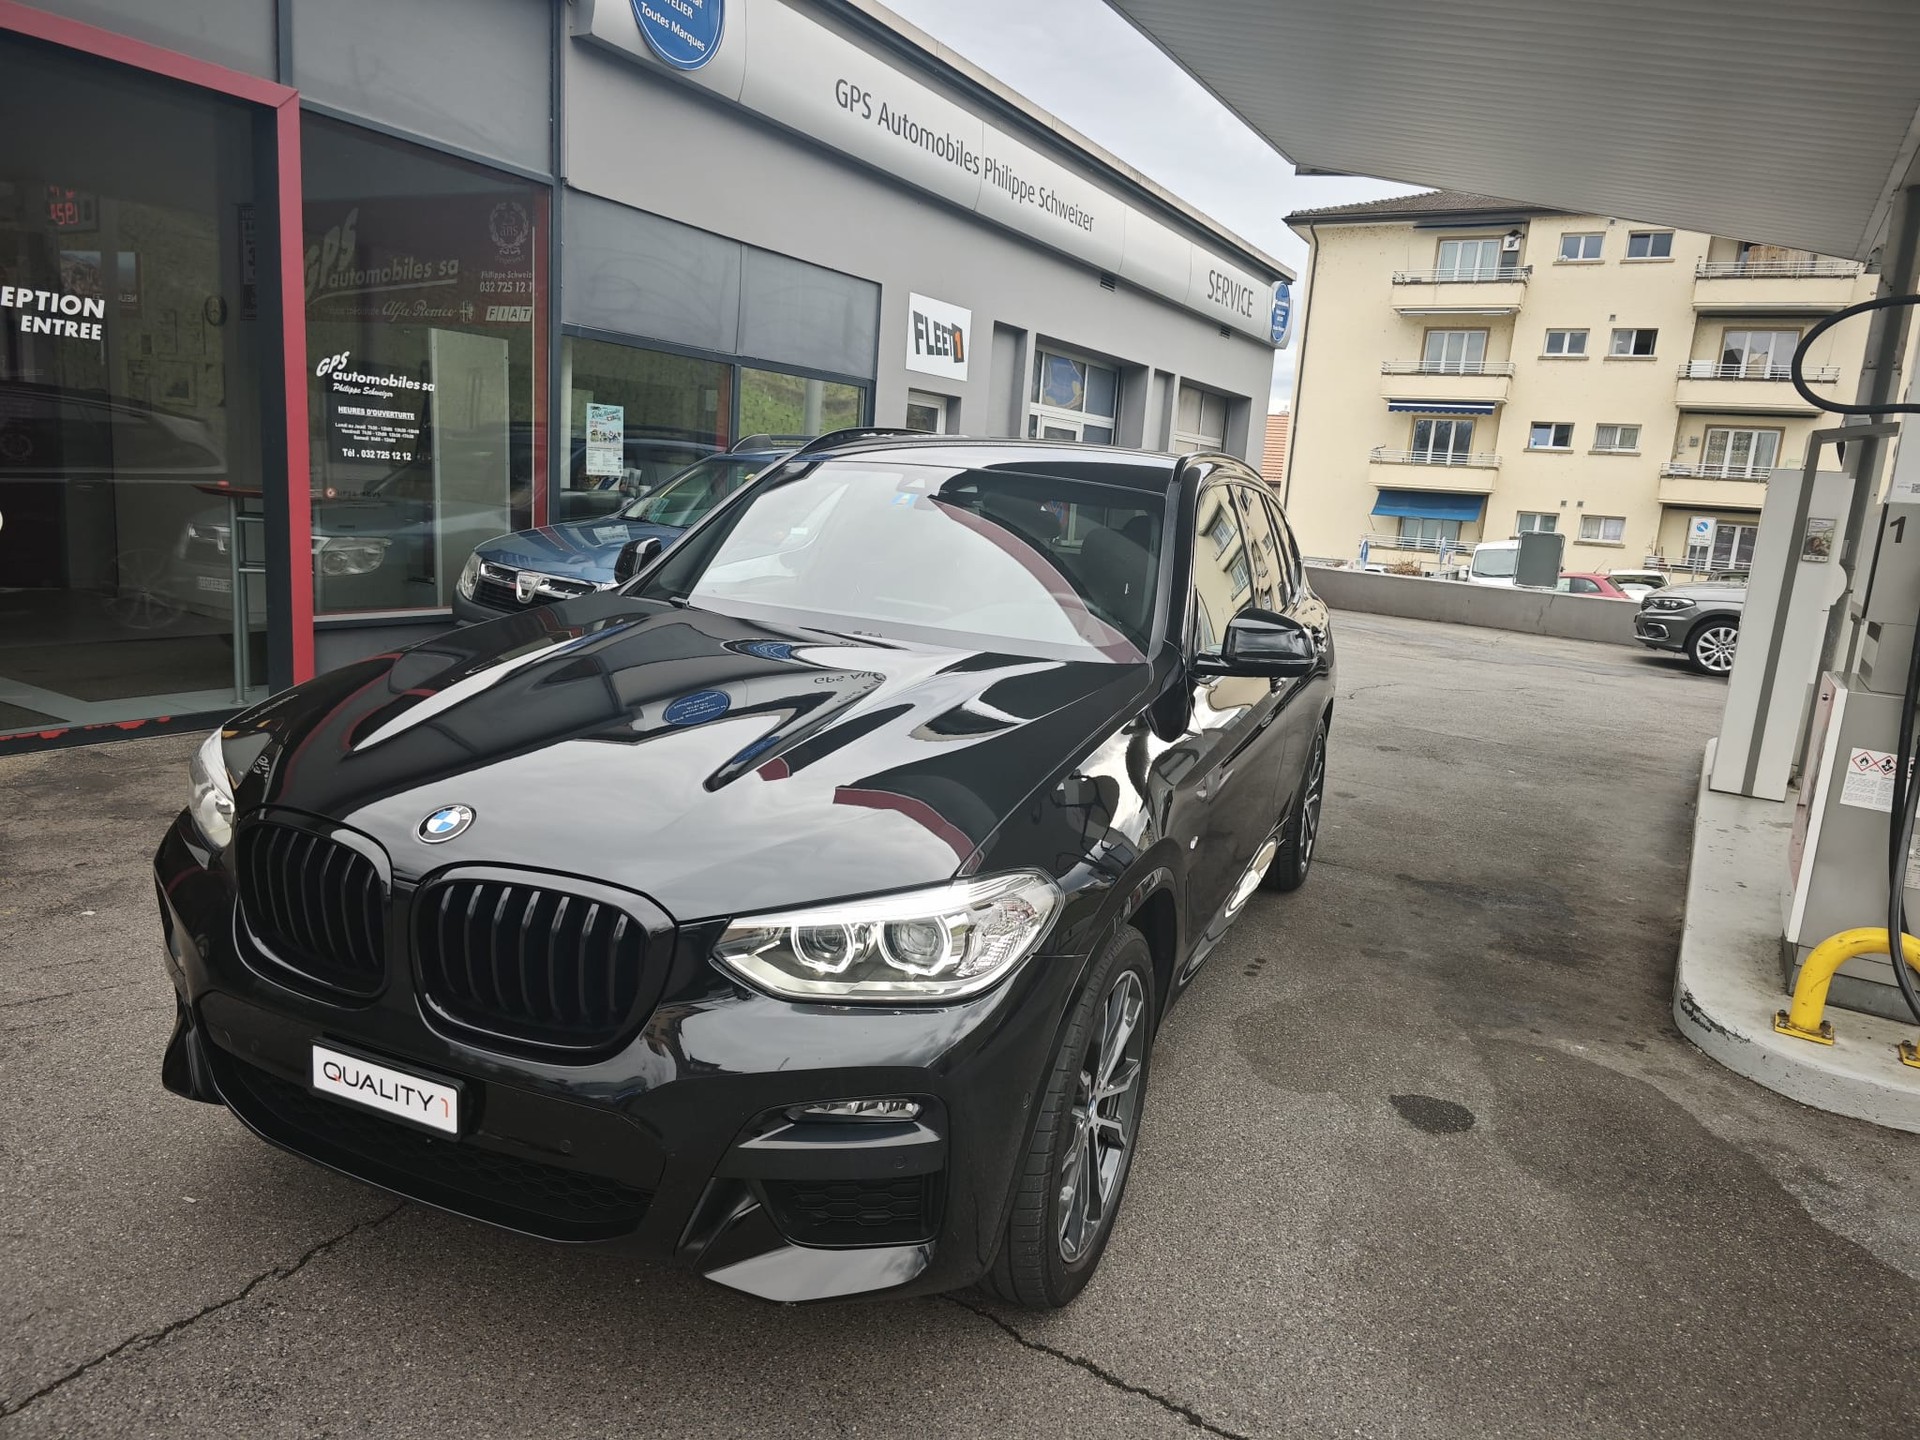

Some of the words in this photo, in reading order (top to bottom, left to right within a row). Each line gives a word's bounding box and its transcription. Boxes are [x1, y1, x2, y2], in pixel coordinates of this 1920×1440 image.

[664, 0, 693, 19] ELIER
[640, 2, 670, 28] Toutes
[671, 21, 706, 51] Marques
[835, 79, 872, 119] GPS
[878, 102, 980, 175] Automobiles
[984, 157, 1035, 204] Philippe
[1038, 187, 1094, 232] Schweizer
[329, 256, 432, 288] automobiles
[438, 259, 459, 275] sa
[480, 281, 496, 293] 032
[497, 281, 513, 293] 725
[515, 281, 527, 293] 12
[1207, 269, 1254, 318] SERVICE
[1, 286, 105, 319] EPTION
[488, 307, 531, 321] FIAT
[20, 315, 103, 341] ENTREE
[316, 351, 350, 377] GPS
[332, 382, 361, 395] Philippe
[362, 387, 393, 399] Schweizer
[333, 370, 421, 390] automobiles
[421, 382, 435, 392] sa
[338, 406, 366, 415] HEURES
[361, 449, 375, 459] 032
[376, 450, 390, 459] 725
[392, 451, 401, 460] 12
[402, 452, 411, 461] 12
[1889, 516, 1906, 543] 1
